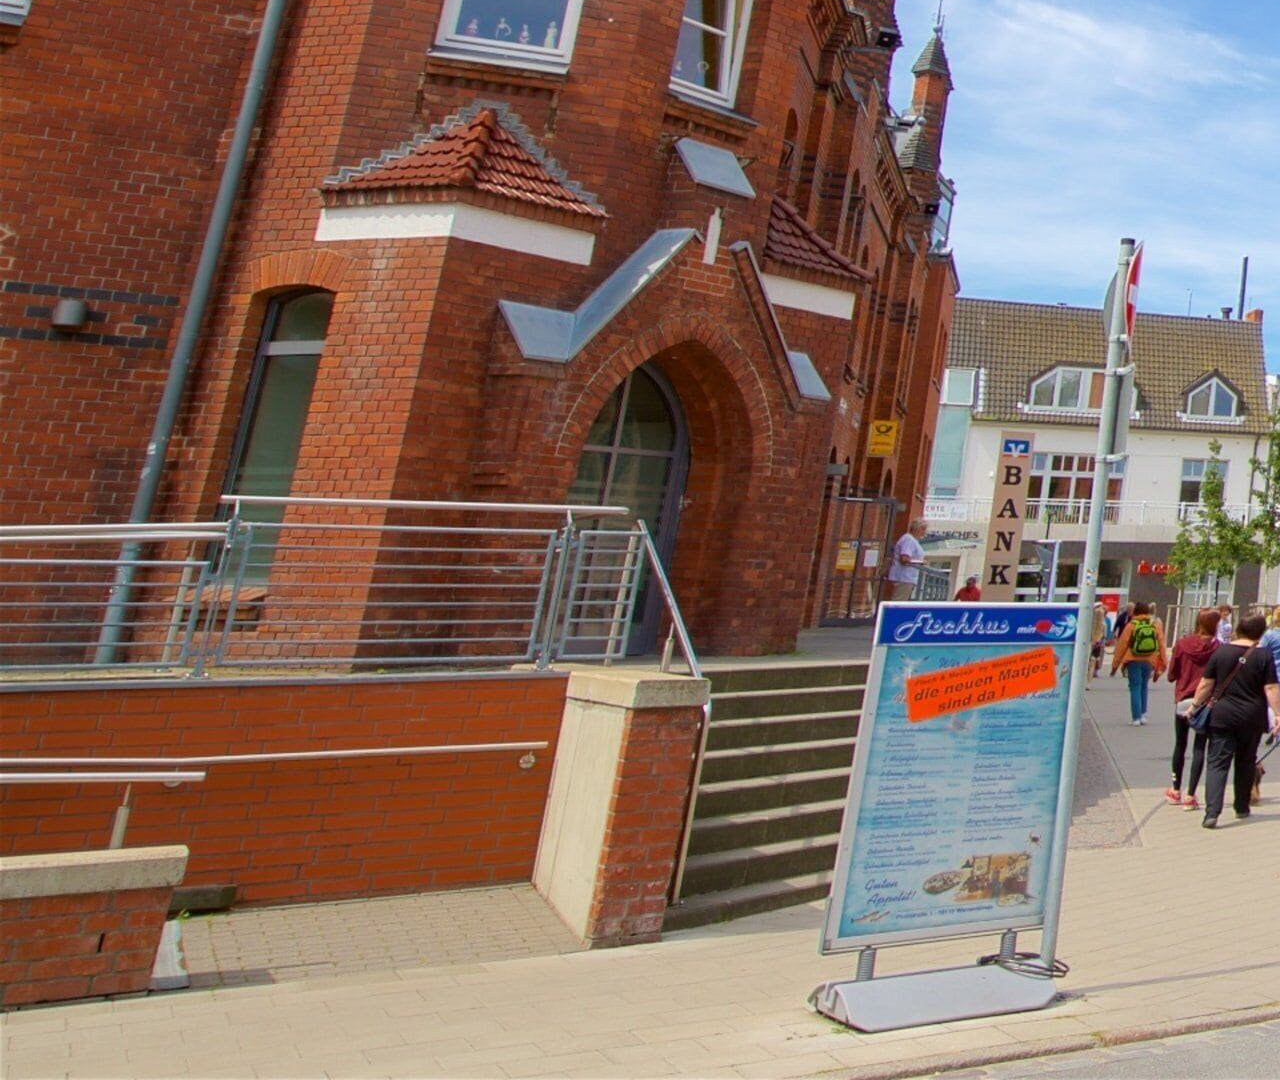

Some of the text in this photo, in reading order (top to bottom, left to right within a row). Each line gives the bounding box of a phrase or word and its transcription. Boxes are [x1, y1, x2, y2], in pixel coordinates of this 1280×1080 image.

[988, 465, 1022, 585] BANK
[894, 611, 1010, 642] Fischhus
[914, 687, 939, 701] die
[944, 676, 993, 695] neuen
[997, 661, 1049, 683] Matjes
[938, 693, 972, 713] sind
[977, 689, 996, 705] da
[864, 878, 899, 892] Guten
